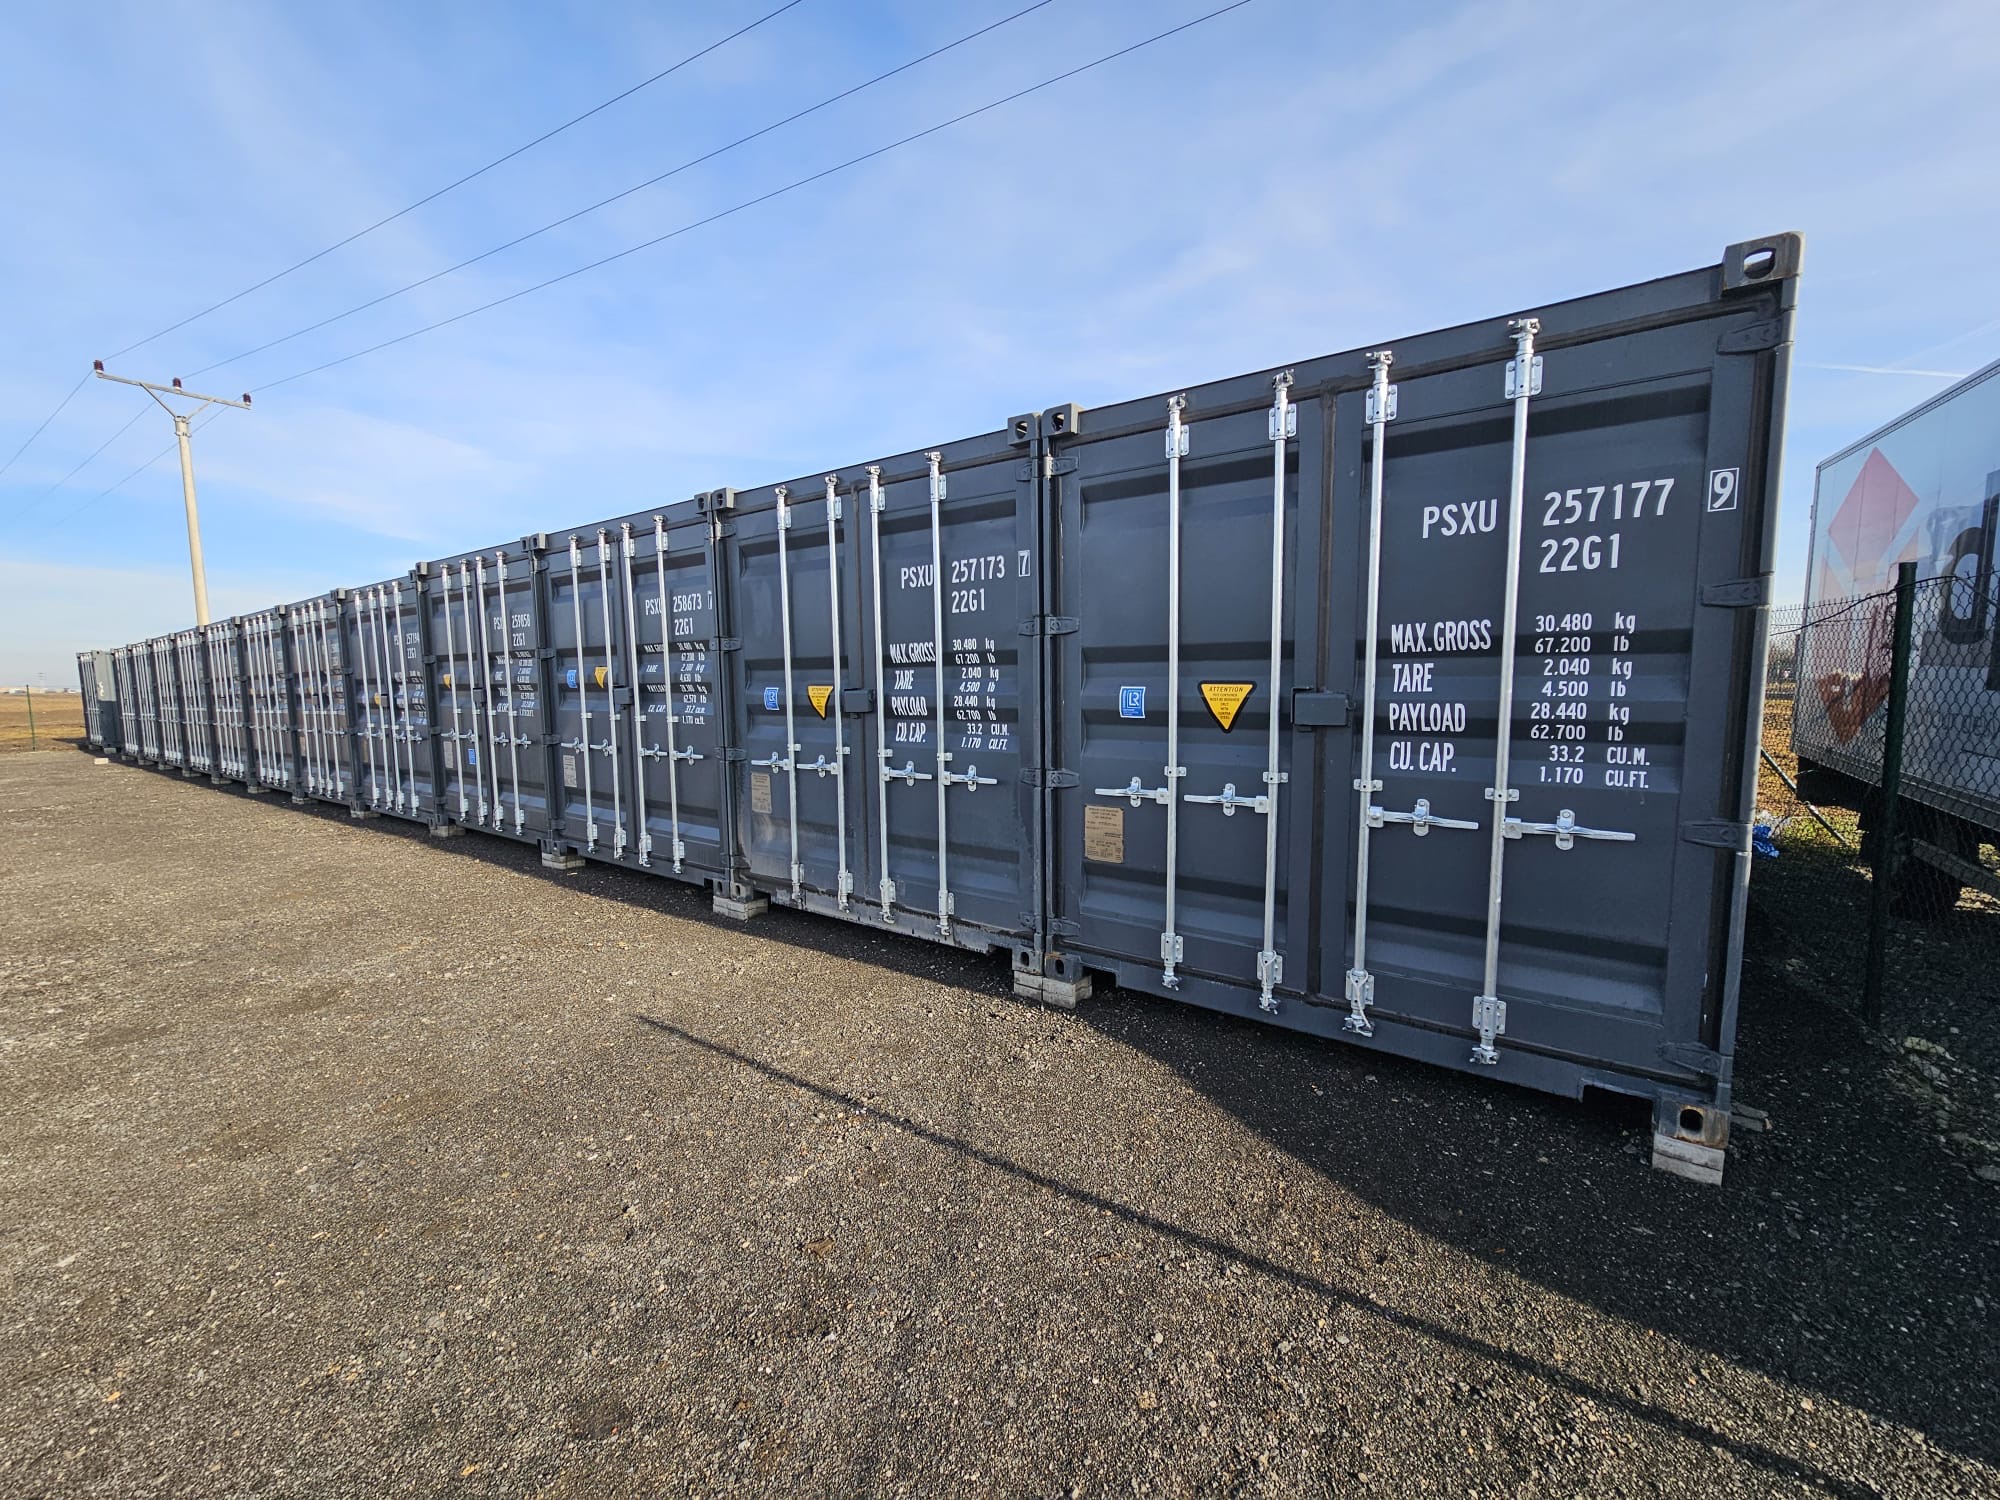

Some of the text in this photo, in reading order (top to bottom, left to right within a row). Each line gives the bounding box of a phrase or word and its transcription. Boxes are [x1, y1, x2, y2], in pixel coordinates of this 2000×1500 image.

[1422, 471, 1736, 539] PSXU 257177 9
[1540, 533, 1620, 573] 22G1
[900, 564, 934, 589] PSXU
[951, 555, 1005, 583] 257173
[673, 593, 702, 612] 258673
[951, 588, 985, 613] 22G1
[674, 617, 694, 636] 22G1
[1535, 612, 1636, 634] 30.480 kg
[952, 638, 995, 652] 30.480 kg
[1391, 619, 1492, 654] MAX.GROSS
[1534, 636, 1630, 653] 67.200 lb
[889, 641, 936, 664] MAX.GROSS
[955, 652, 996, 665] 67.200 lb
[695, 663, 705, 673] kg
[961, 667, 999, 681] 2.040 kg
[1392, 662, 1435, 692] TARE
[1543, 657, 1633, 680] 2.040 kg
[894, 670, 914, 690] TARE
[959, 682, 996, 693] 4.500 lb
[1541, 680, 1627, 697] 4.500 lb
[891, 696, 928, 716] PAYLOAD
[953, 695, 996, 710] 28.440 kg
[956, 709, 997, 721] 62.700 lb
[1389, 702, 1466, 732] PAYLOAD
[1530, 702, 1631, 726] 28.440 kg
[908, 722, 926, 743] CAP.
[966, 723, 983, 735] 33.2
[1530, 724, 1624, 742] 62.700 lb
[961, 737, 981, 749] 1.170
[1419, 742, 1457, 773] CAP.
[1549, 745, 1651, 766] 33.2 CU.M.
[1539, 766, 1649, 788] 1.170 CU.FT.
